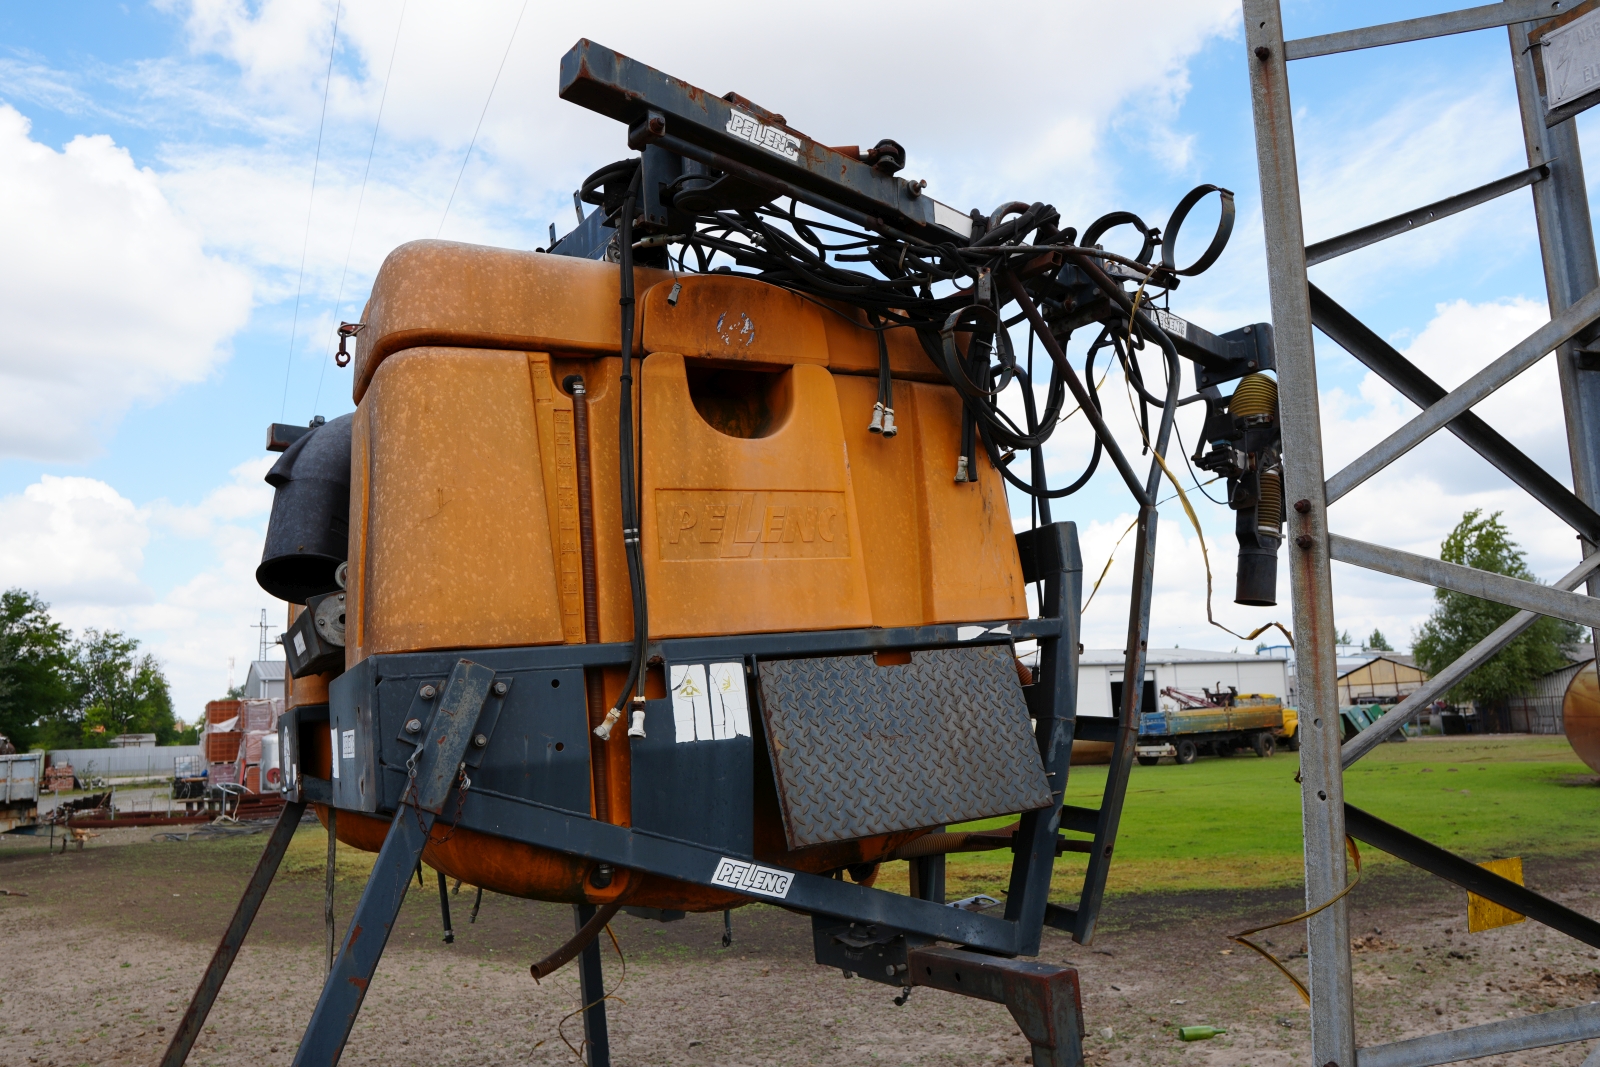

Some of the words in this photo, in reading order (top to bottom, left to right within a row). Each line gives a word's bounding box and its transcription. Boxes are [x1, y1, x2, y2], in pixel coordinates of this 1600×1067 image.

[731, 113, 798, 156] PELLENC
[669, 492, 837, 558] PELLENC
[716, 863, 788, 893] PELLENC
